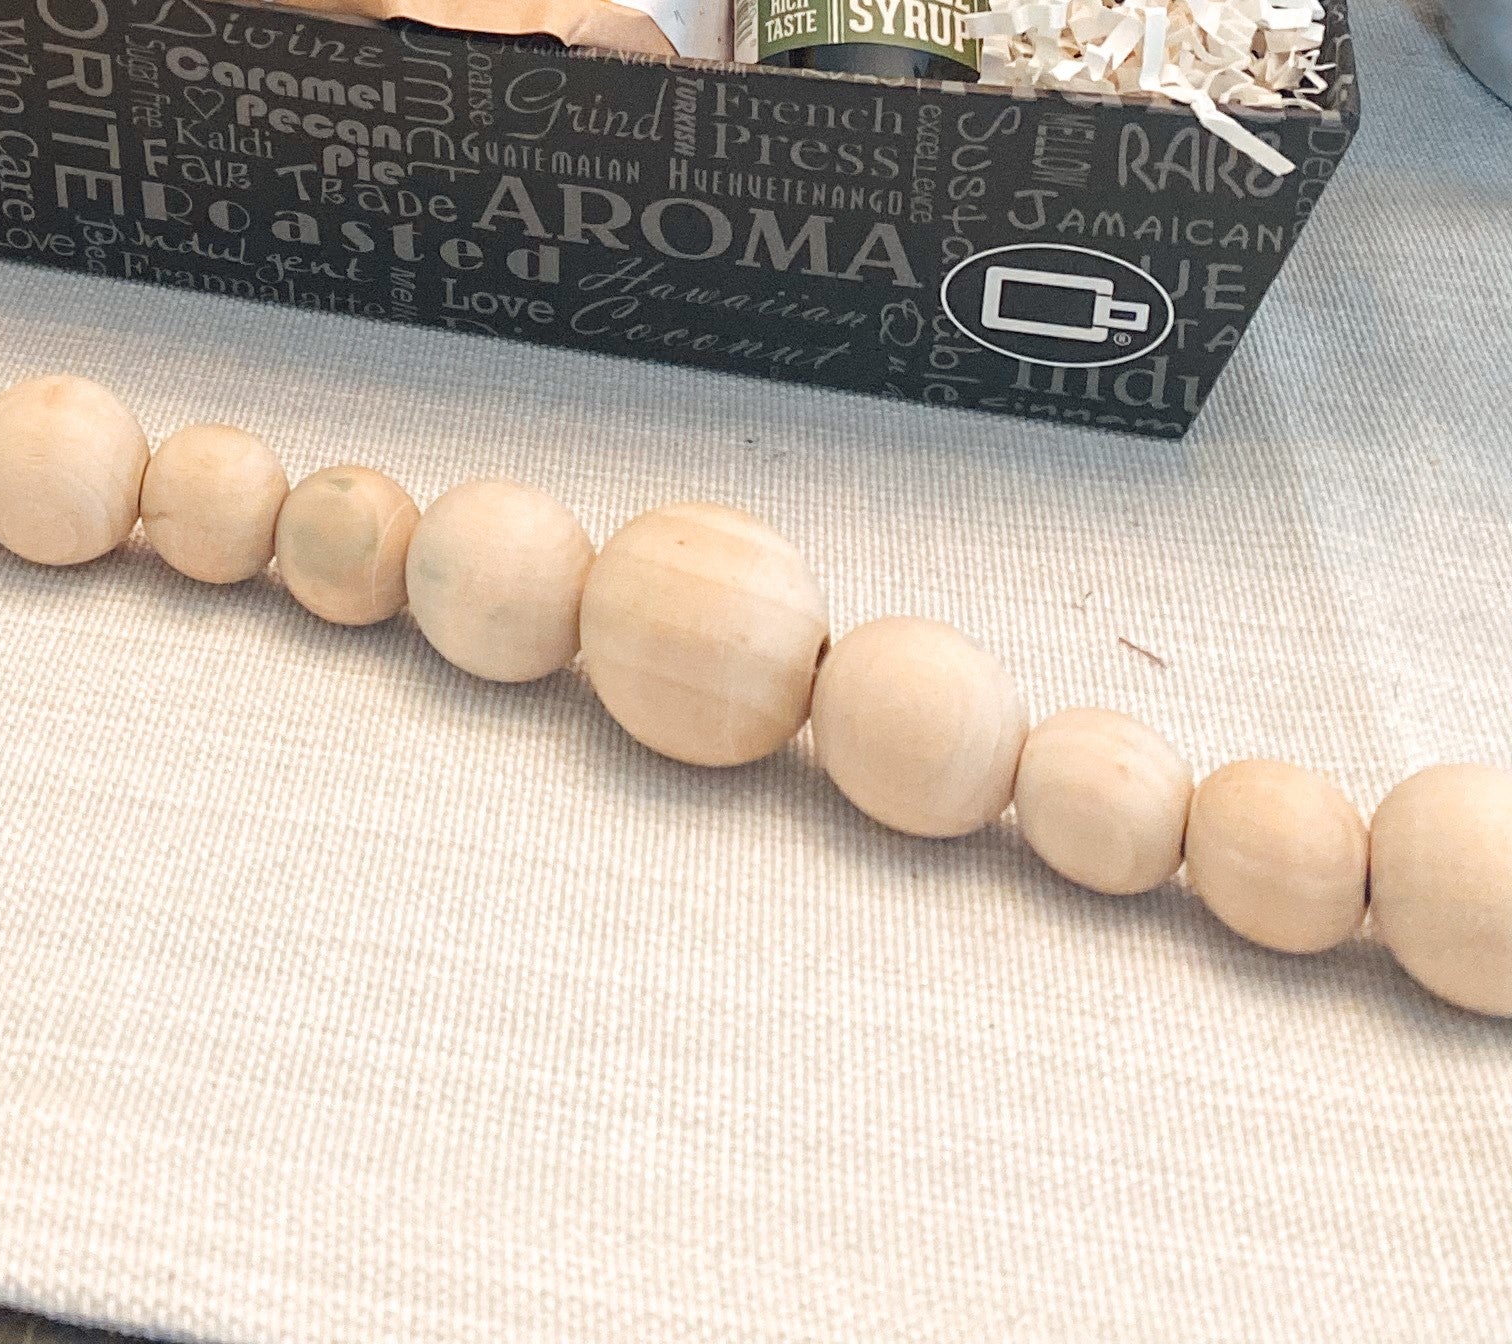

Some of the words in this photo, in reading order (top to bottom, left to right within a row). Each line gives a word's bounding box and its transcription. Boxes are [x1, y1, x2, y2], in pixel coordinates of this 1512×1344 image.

[764, 9, 818, 44] TASTE
[165, 46, 397, 113] Caramel
[504, 67, 669, 140] Grind
[714, 81, 903, 136] French
[175, 116, 274, 160] Kaldi
[236, 93, 402, 151] Pecan
[709, 121, 900, 180] Press
[323, 144, 405, 185] Pie
[140, 180, 561, 284] Roasted
[472, 174, 923, 289] AROMA
[1008, 188, 1284, 253] JAMAICAN
[441, 277, 556, 324] Love
[578, 257, 869, 328] Hawaiian
[570, 295, 851, 370] Coconut
